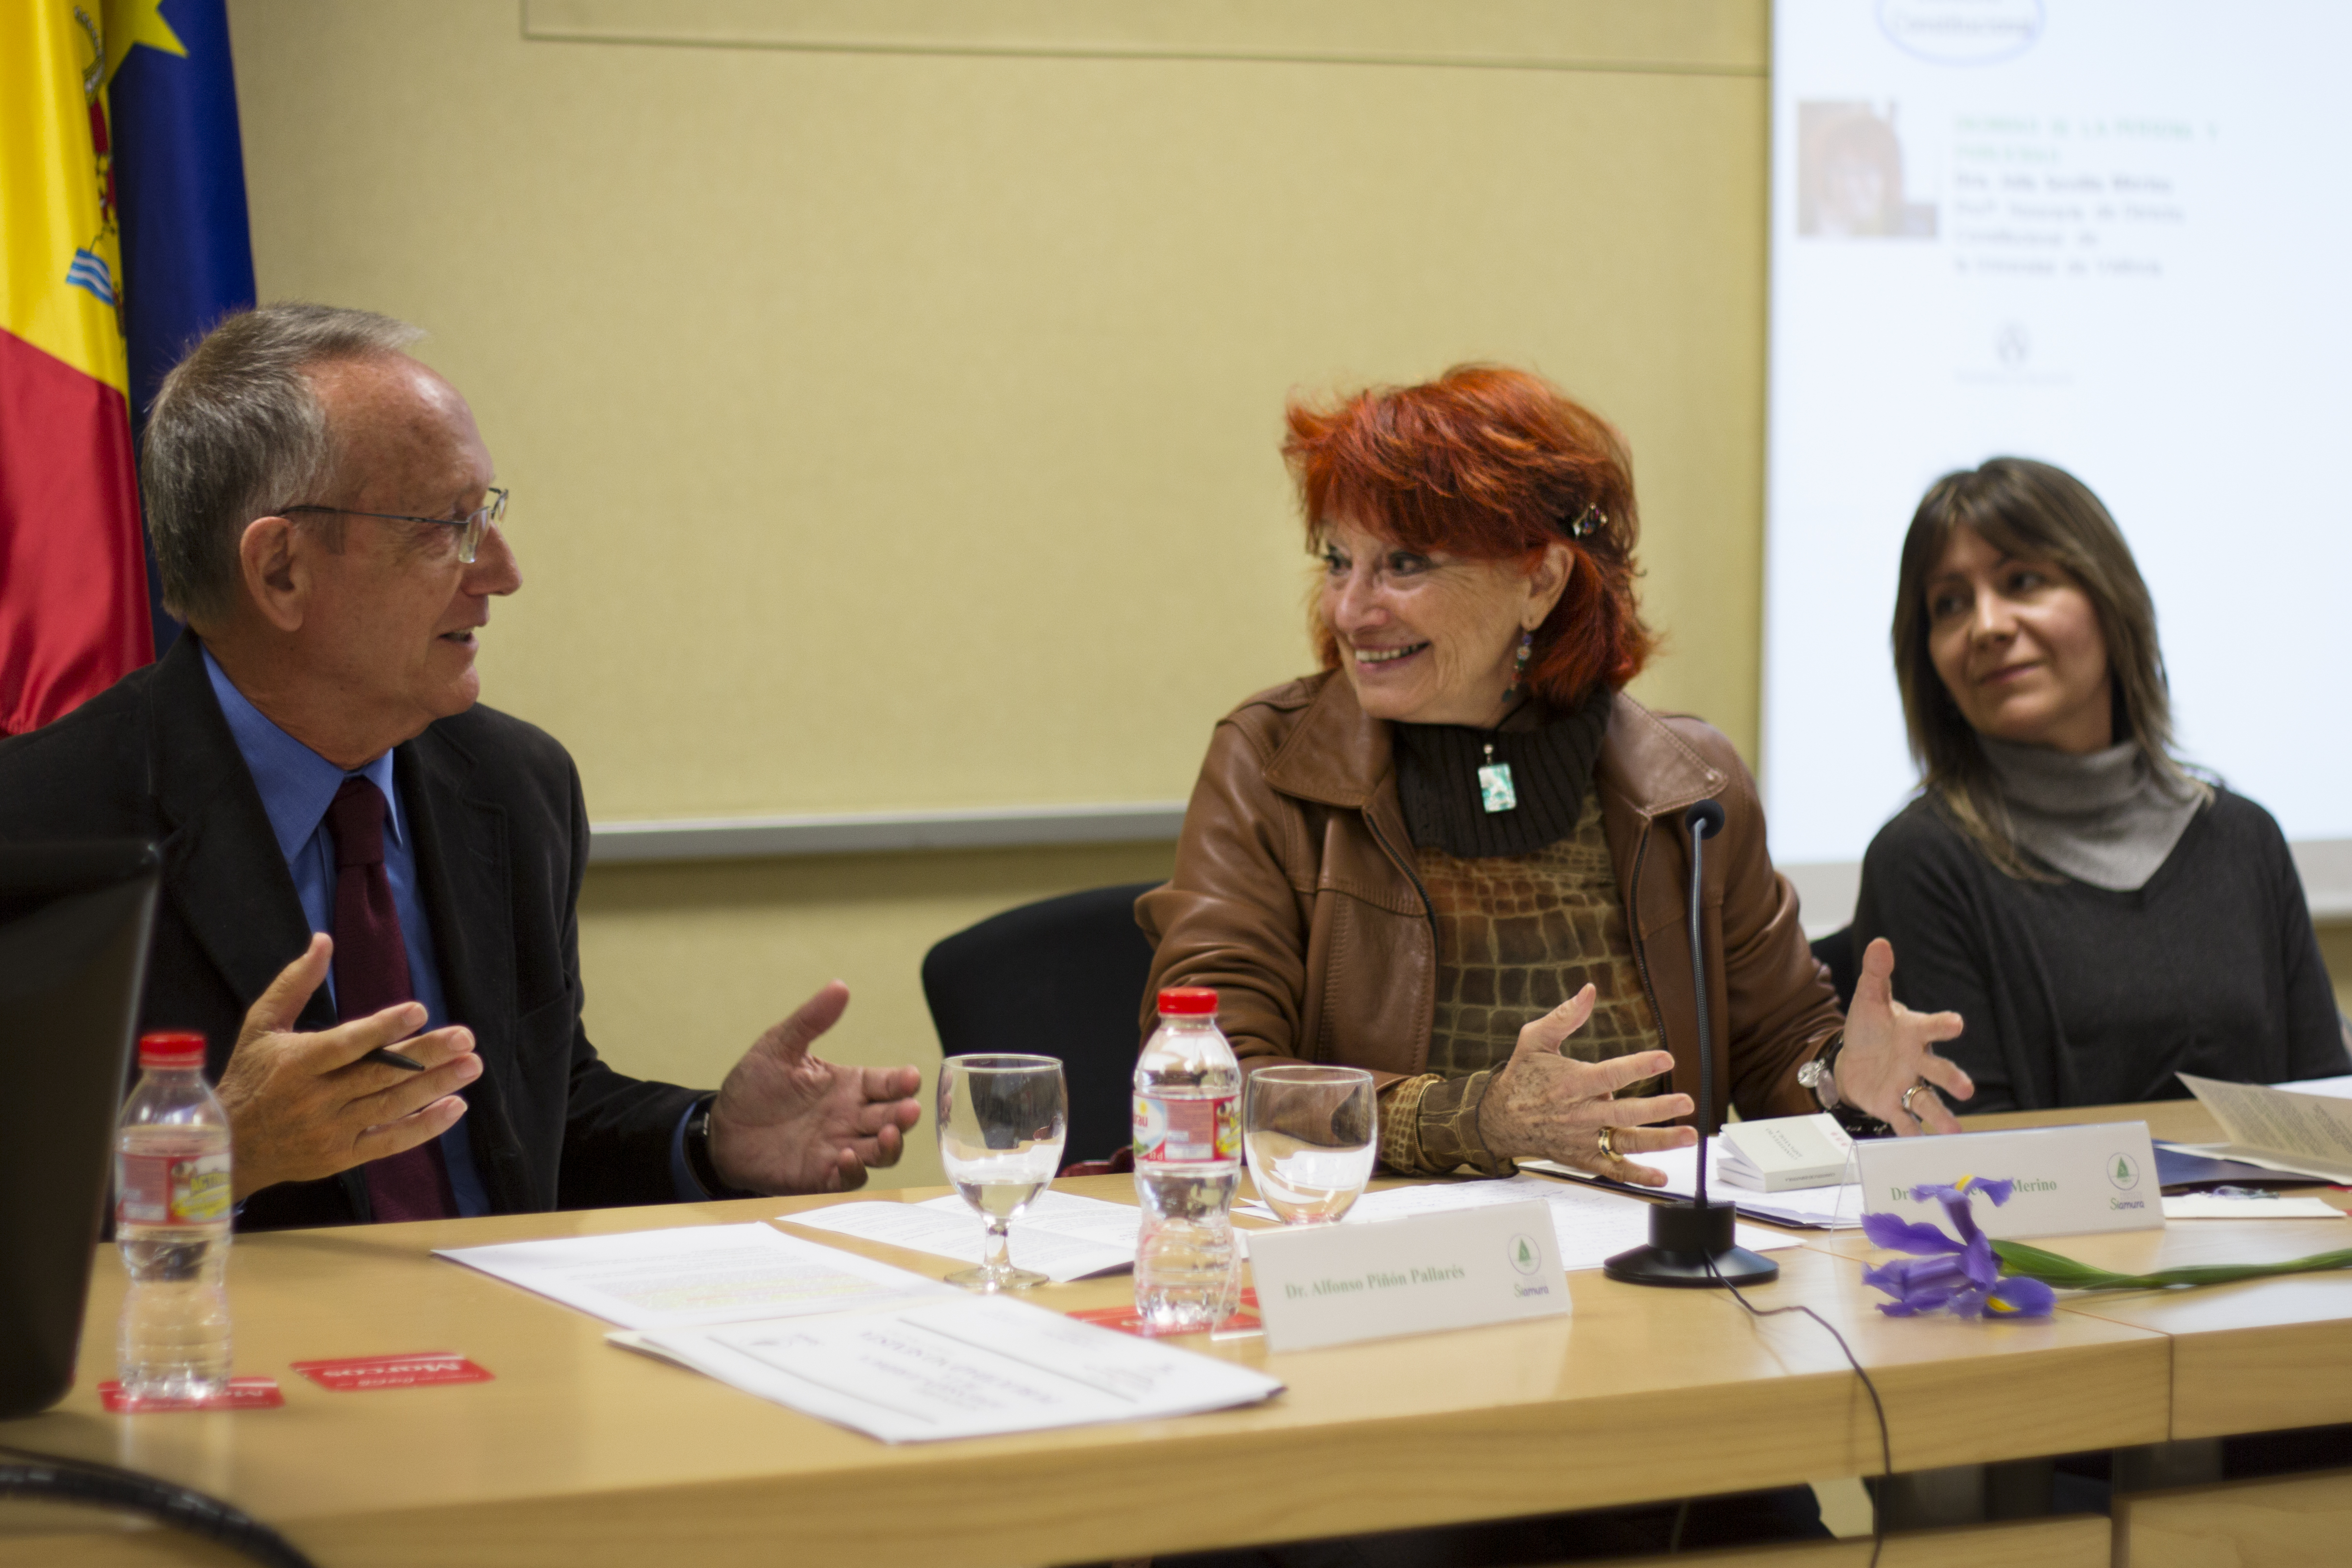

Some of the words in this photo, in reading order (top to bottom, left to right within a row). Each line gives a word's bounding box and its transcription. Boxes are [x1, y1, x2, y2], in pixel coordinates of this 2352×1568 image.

[2012, 1178, 2057, 1193] Merino
[2110, 1197, 2145, 1210] Siamura
[1285, 1283, 1307, 1299] Dr.
[1312, 1277, 1363, 1296] Alfonso
[1366, 1271, 1407, 1289] Piñón
[1410, 1264, 1465, 1285] Pallarés
[1514, 1284, 1550, 1298] Siamura
[323, 1363, 461, 1376] Marcos
